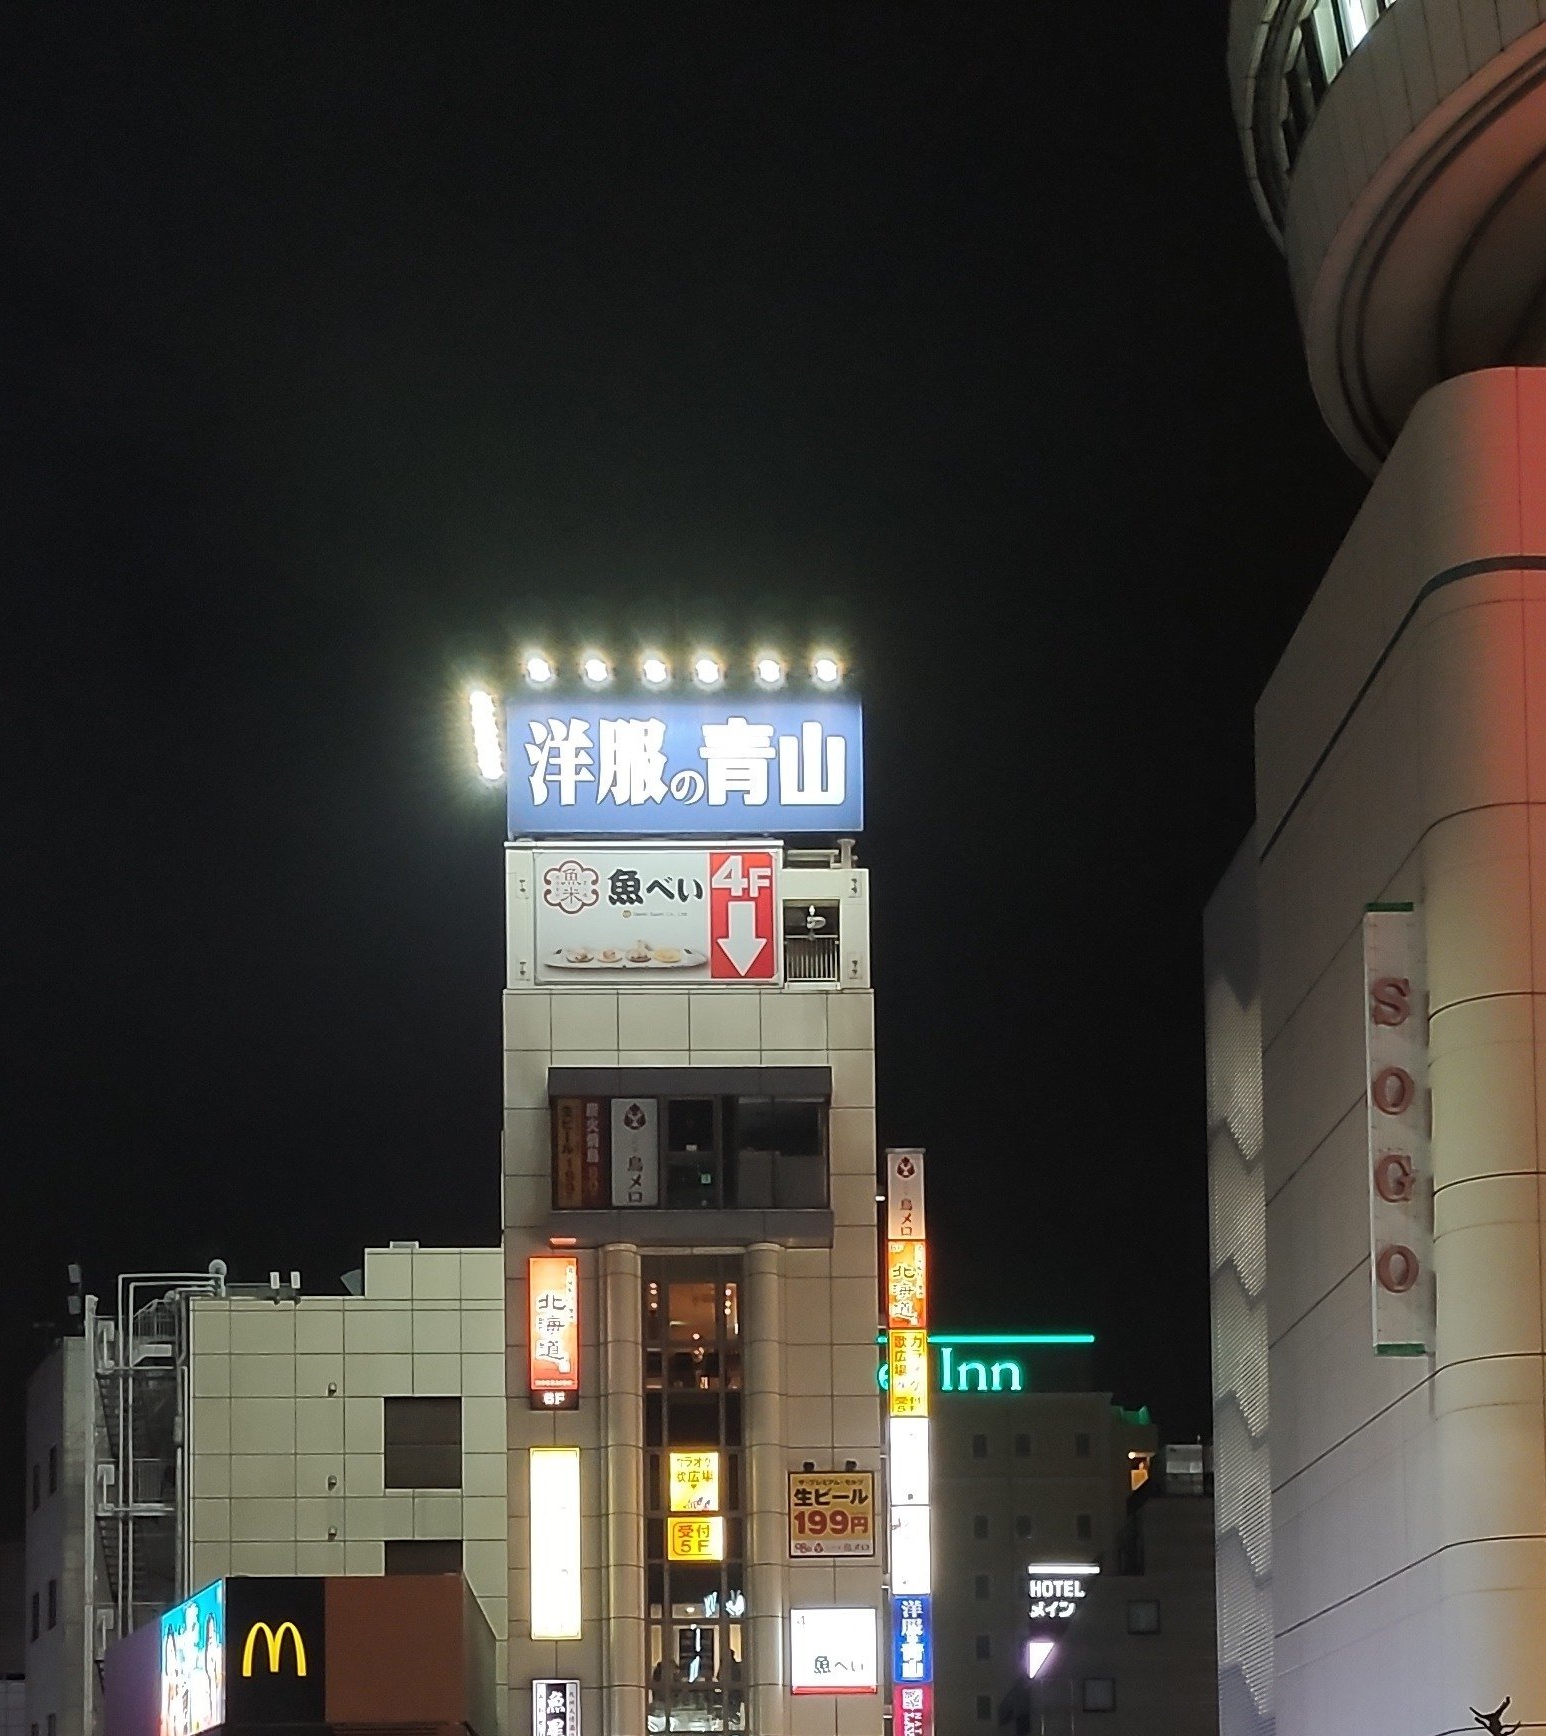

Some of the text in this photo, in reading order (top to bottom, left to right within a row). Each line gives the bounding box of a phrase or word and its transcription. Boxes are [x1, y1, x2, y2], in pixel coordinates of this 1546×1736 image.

[524, 717, 846, 805] 洋服の青山
[608, 868, 703, 905] 魚べい
[711, 855, 771, 897] 4F
[1372, 977, 1420, 1294] SOGO
[940, 1348, 1022, 1391] Inn
[794, 1488, 869, 1507] 生ビール
[678, 1525, 710, 1538] 受付
[794, 1510, 869, 1534] 199円
[681, 1540, 710, 1552] 5F
[1029, 1580, 1086, 1598] HOTEL
[1029, 1601, 1076, 1618] メイン
